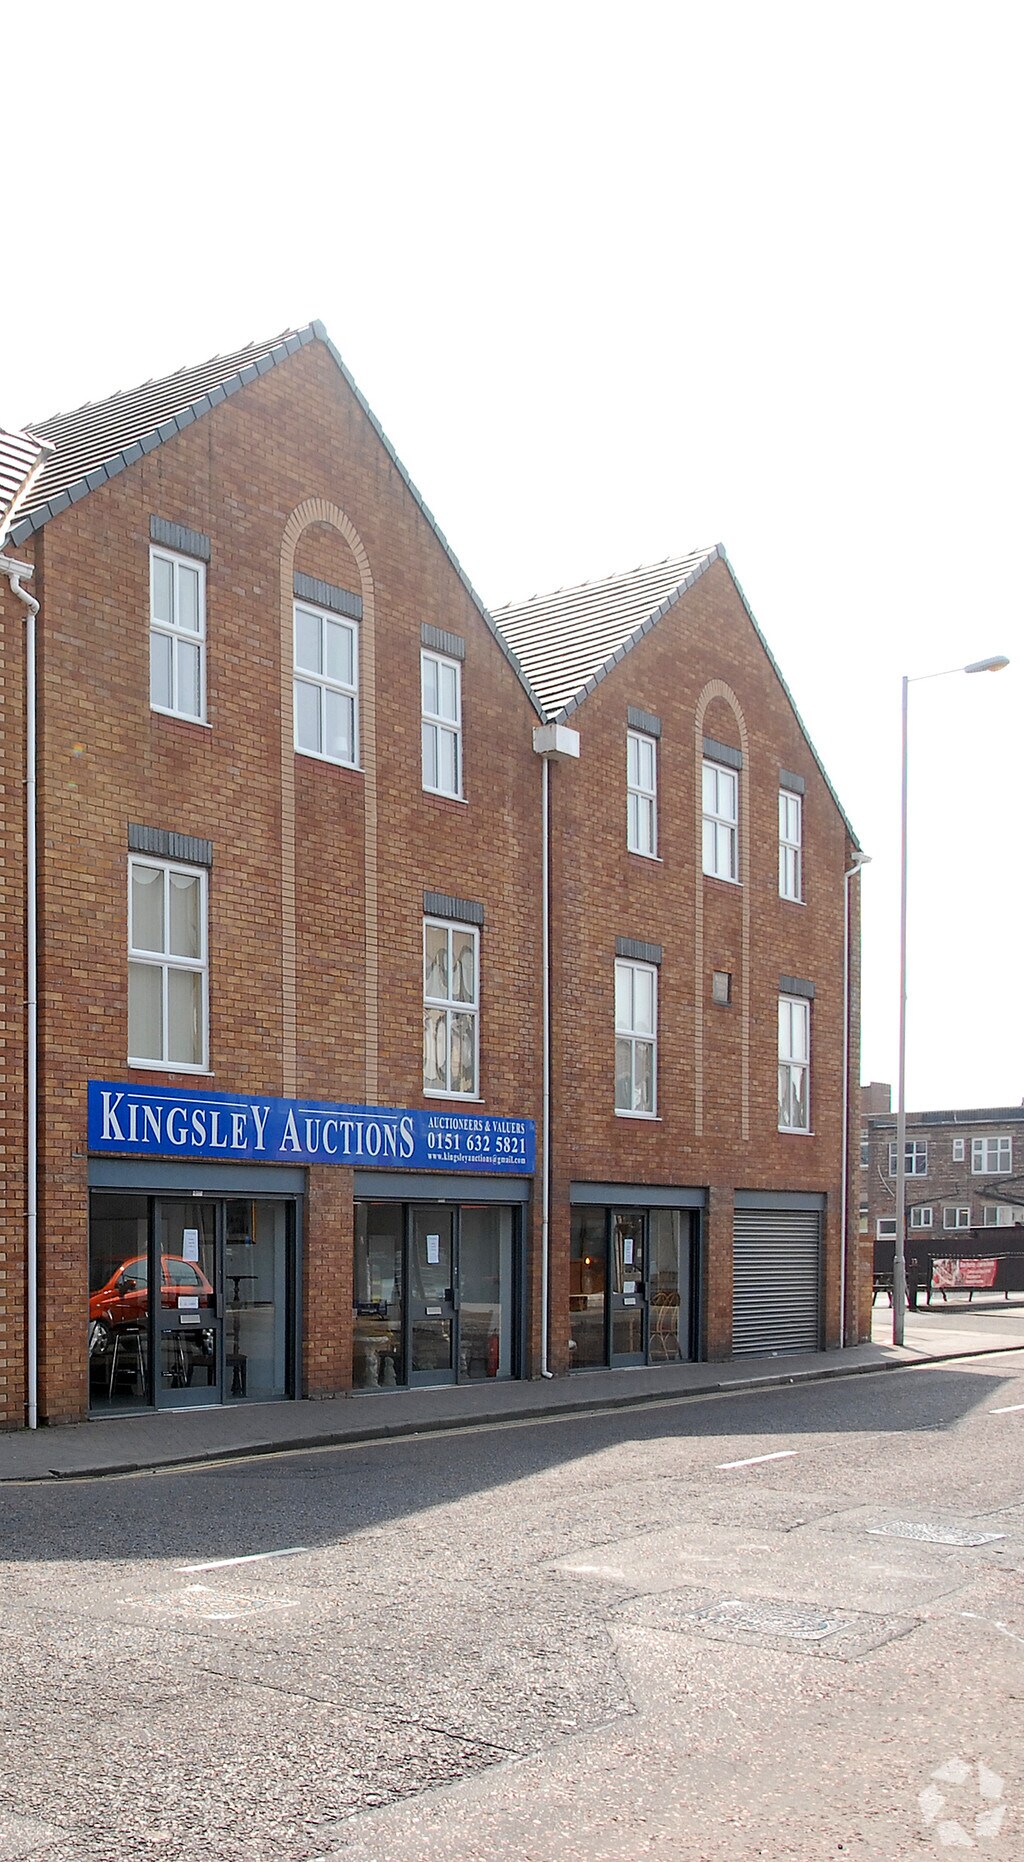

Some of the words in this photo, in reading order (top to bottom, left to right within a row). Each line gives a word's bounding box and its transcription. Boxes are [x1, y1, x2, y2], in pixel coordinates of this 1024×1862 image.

[100, 1091, 270, 1151] KINGSLEY
[279, 1108, 415, 1158] AUCTIONS
[428, 1117, 483, 1131] AUCTIONEERS
[485, 1121, 491, 1132] &
[493, 1121, 525, 1134] VALUERS
[428, 1132, 460, 1150] 0151
[466, 1135, 490, 1152] 632
[496, 1136, 526, 1153] 5821
